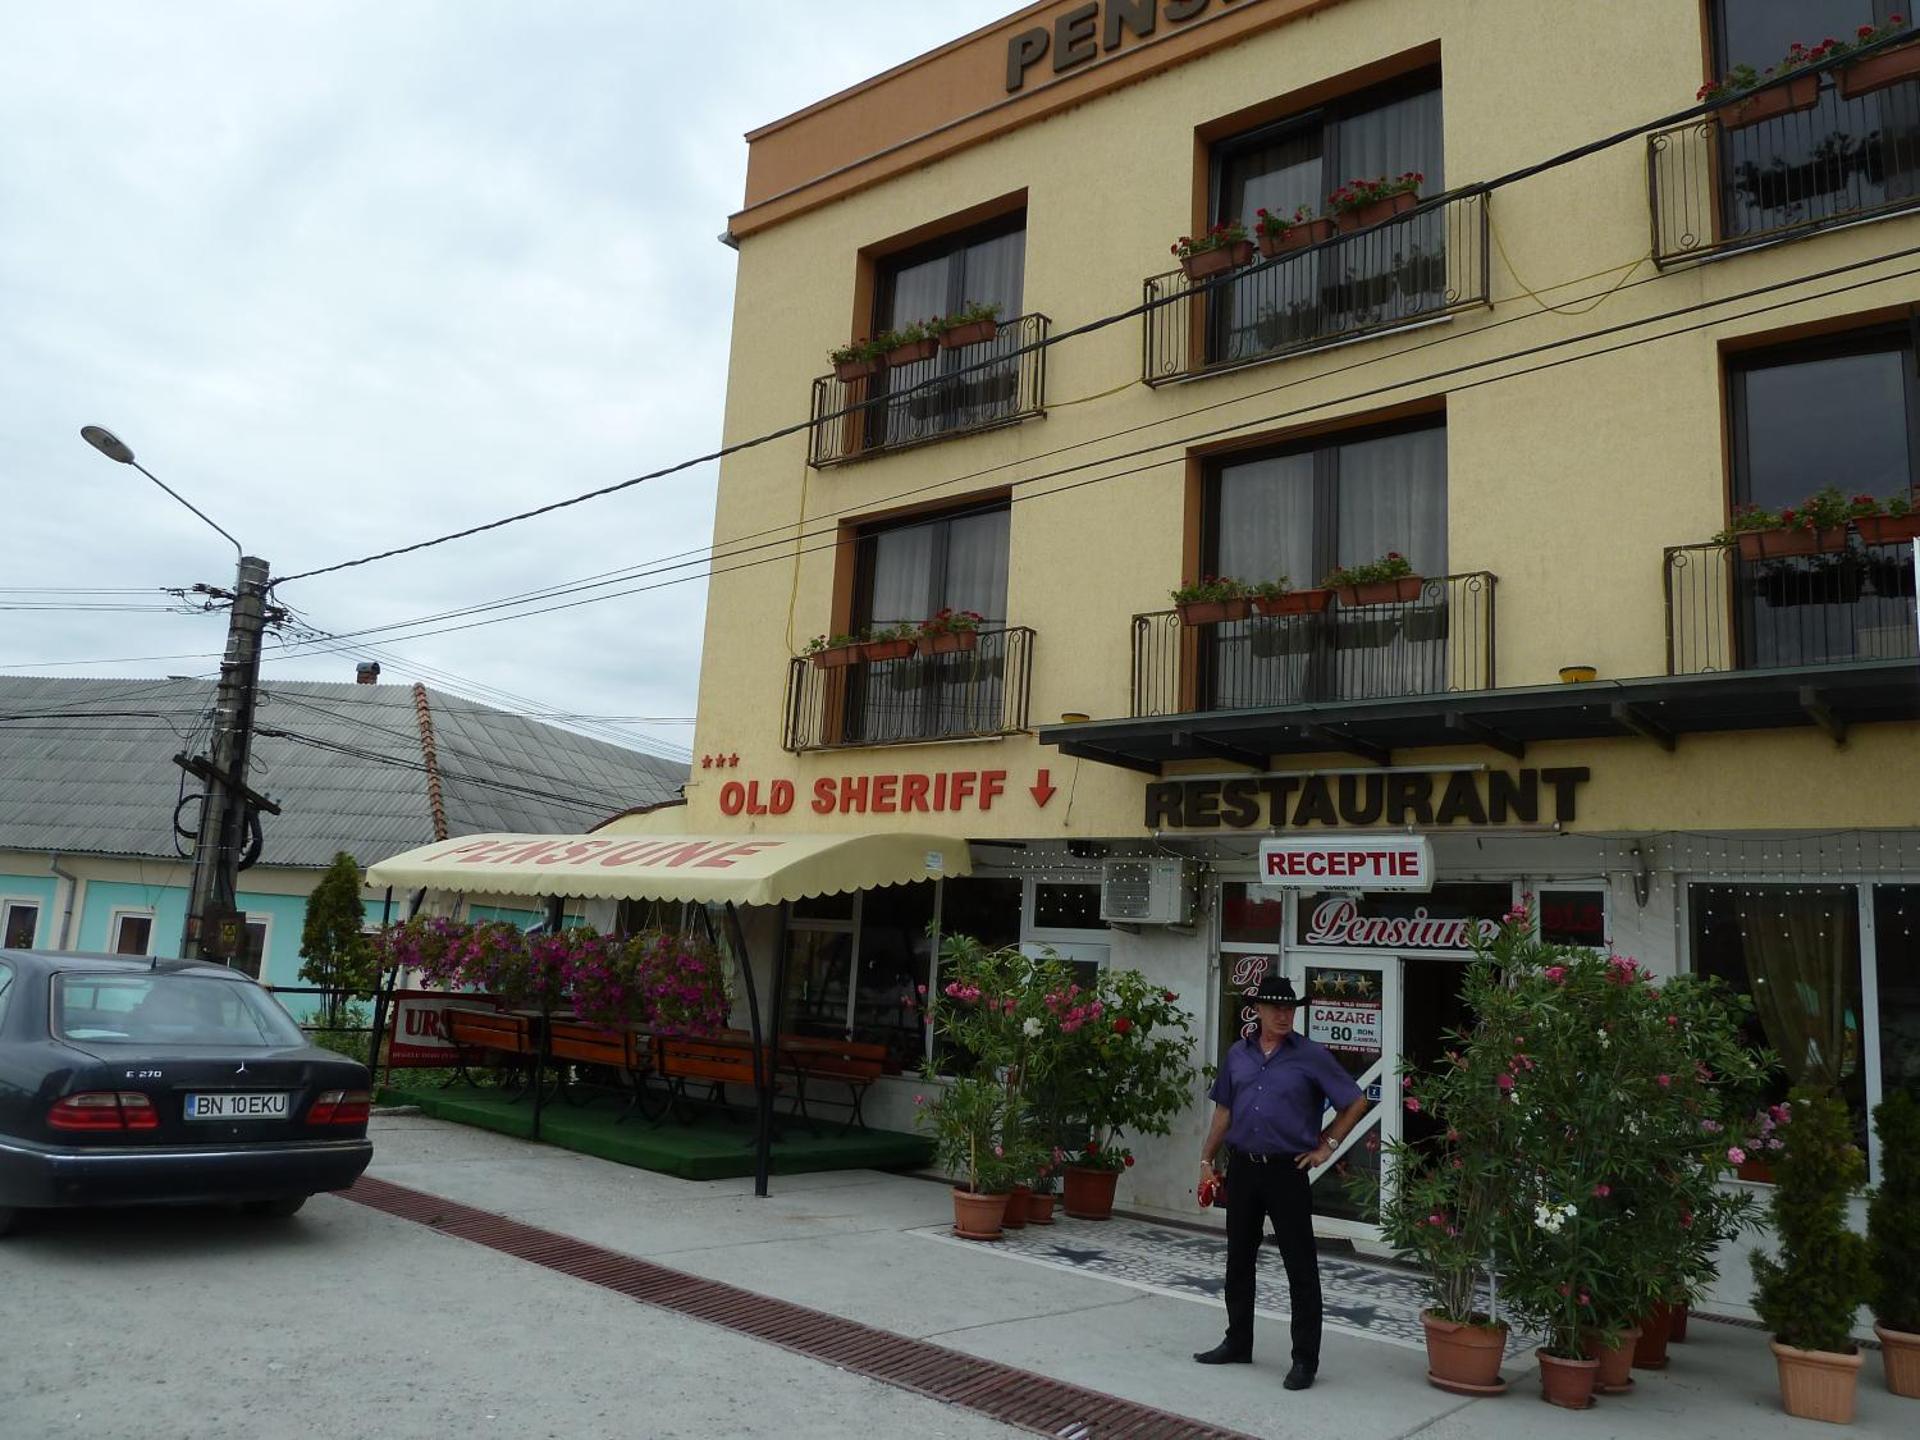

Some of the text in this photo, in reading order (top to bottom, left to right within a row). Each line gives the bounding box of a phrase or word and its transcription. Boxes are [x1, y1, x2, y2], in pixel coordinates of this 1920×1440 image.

[719, 770, 1007, 816] OLD SHERIFF
[1145, 766, 1590, 828] RESTAURANT
[424, 840, 786, 869] PENSIUNE
[1266, 851, 1419, 876] RECEPTIE
[1314, 1010, 1376, 1025] CAZARE
[1330, 1026, 1352, 1041] 80
[125, 1070, 162, 1078] E 270
[197, 1096, 223, 1115] BN
